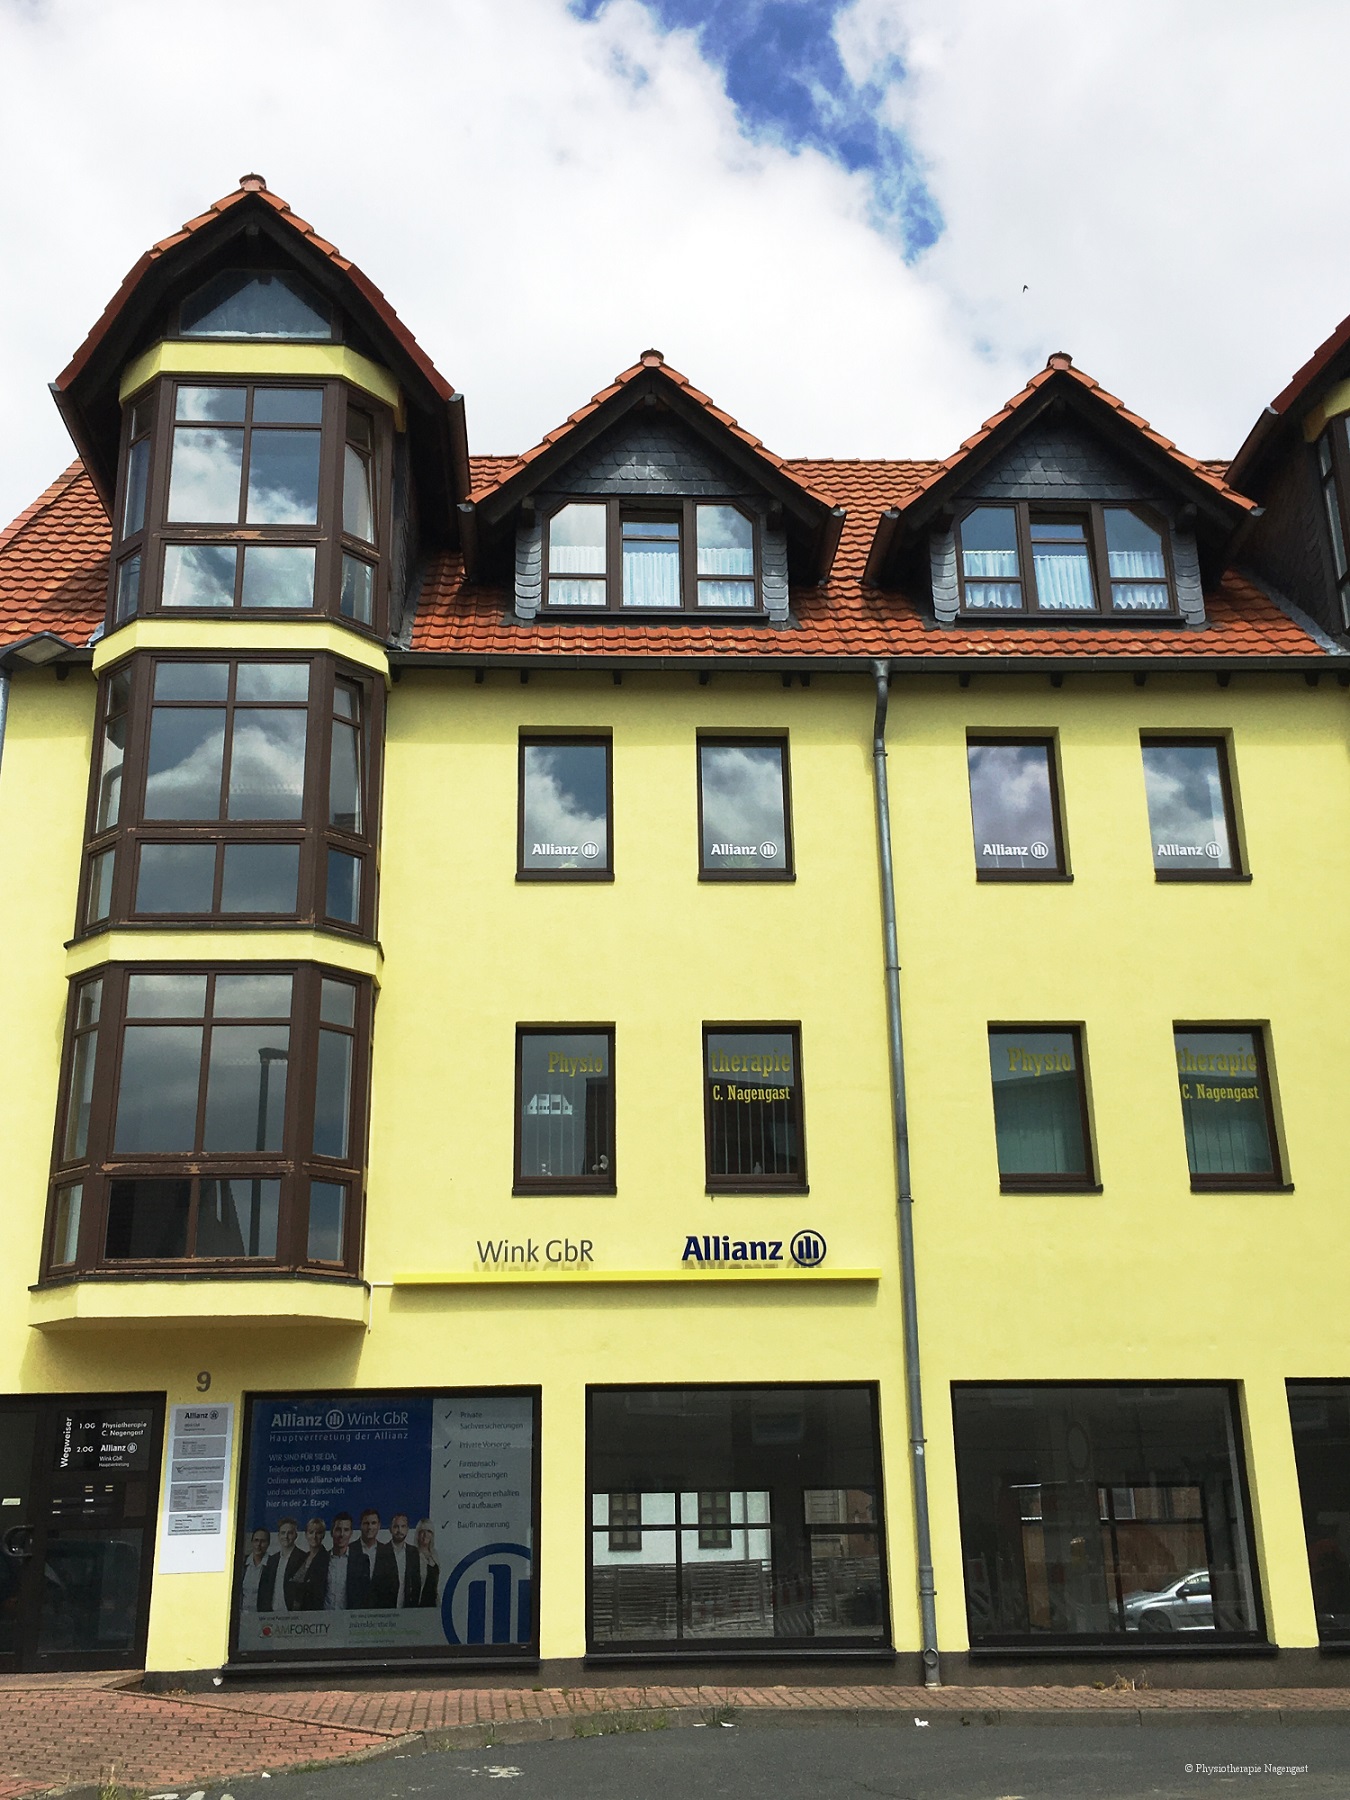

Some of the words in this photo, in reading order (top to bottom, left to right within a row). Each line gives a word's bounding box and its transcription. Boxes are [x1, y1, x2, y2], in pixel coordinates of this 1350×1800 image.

[532, 843, 578, 856] Allianz
[711, 843, 757, 856] Allianz
[983, 844, 1028, 856] Allianz
[1157, 844, 1203, 856] Allianz
[548, 1051, 604, 1077] Physio
[710, 1049, 791, 1077] therapie
[1007, 1047, 1072, 1076] Physio
[1177, 1047, 1257, 1076] therapie
[713, 1085, 723, 1101] C.
[728, 1084, 790, 1103] Nagengast
[1182, 1084, 1193, 1099] C.
[1197, 1083, 1259, 1102] Nagengast
[477, 1238, 539, 1263] Wink
[545, 1238, 594, 1263] GbR
[682, 1235, 783, 1261] Allianz
[196, 1371, 211, 1392] 9
[184, 1411, 208, 1419] Allianz
[271, 1413, 322, 1428] Allianz
[347, 1411, 380, 1426] Wink
[383, 1411, 408, 1425] GbR
[79, 1422, 96, 1430] 1.OG
[102, 1421, 147, 1430] Physiotherapie
[109, 1429, 144, 1438] Nagengast
[60, 1417, 73, 1468] Wegweiser
[269, 1432, 351, 1444] Hauptvertretung
[355, 1431, 371, 1440] der
[374, 1431, 409, 1440] Allianz
[100, 1444, 126, 1452] Allianz
